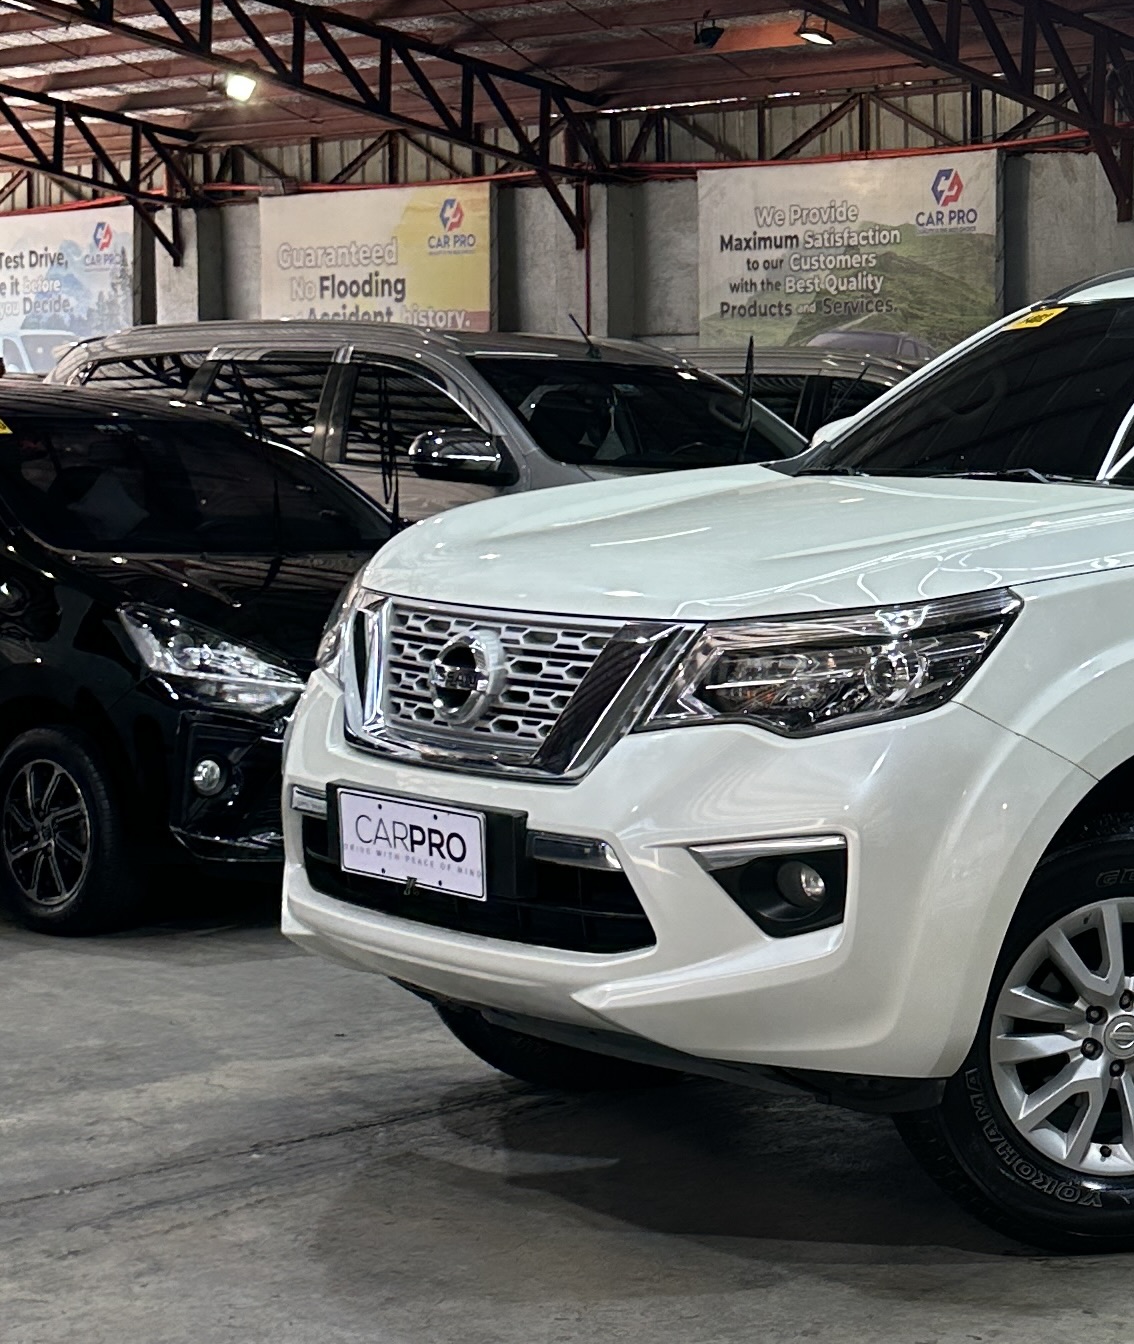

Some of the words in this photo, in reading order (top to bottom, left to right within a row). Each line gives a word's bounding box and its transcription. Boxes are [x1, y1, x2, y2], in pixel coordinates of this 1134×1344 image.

[755, 206, 786, 228] We
[789, 200, 859, 226] Provide
[915, 211, 945, 227] CAR
[948, 208, 978, 225] PRO
[428, 235, 450, 249] CAR
[453, 233, 476, 248] PRO
[720, 231, 799, 252] Maximum
[803, 226, 901, 249] Satisfaction
[29, 246, 69, 270] Drive,
[278, 237, 398, 269] Guaranteed
[746, 258, 760, 271] to
[763, 259, 784, 271] our
[789, 253, 877, 272] Customers
[290, 276, 316, 301] No
[319, 271, 406, 302] Flooding
[729, 277, 757, 293] with
[760, 277, 781, 292] the
[785, 276, 821, 294] Best
[824, 271, 884, 294] Quality
[23, 294, 74, 315] Decide.
[720, 300, 792, 318] Products
[797, 302, 817, 314] and
[822, 295, 898, 315] Services.
[355, 814, 467, 863] CARPRO
[965, 1067, 1103, 1207] YOKOHAMA
